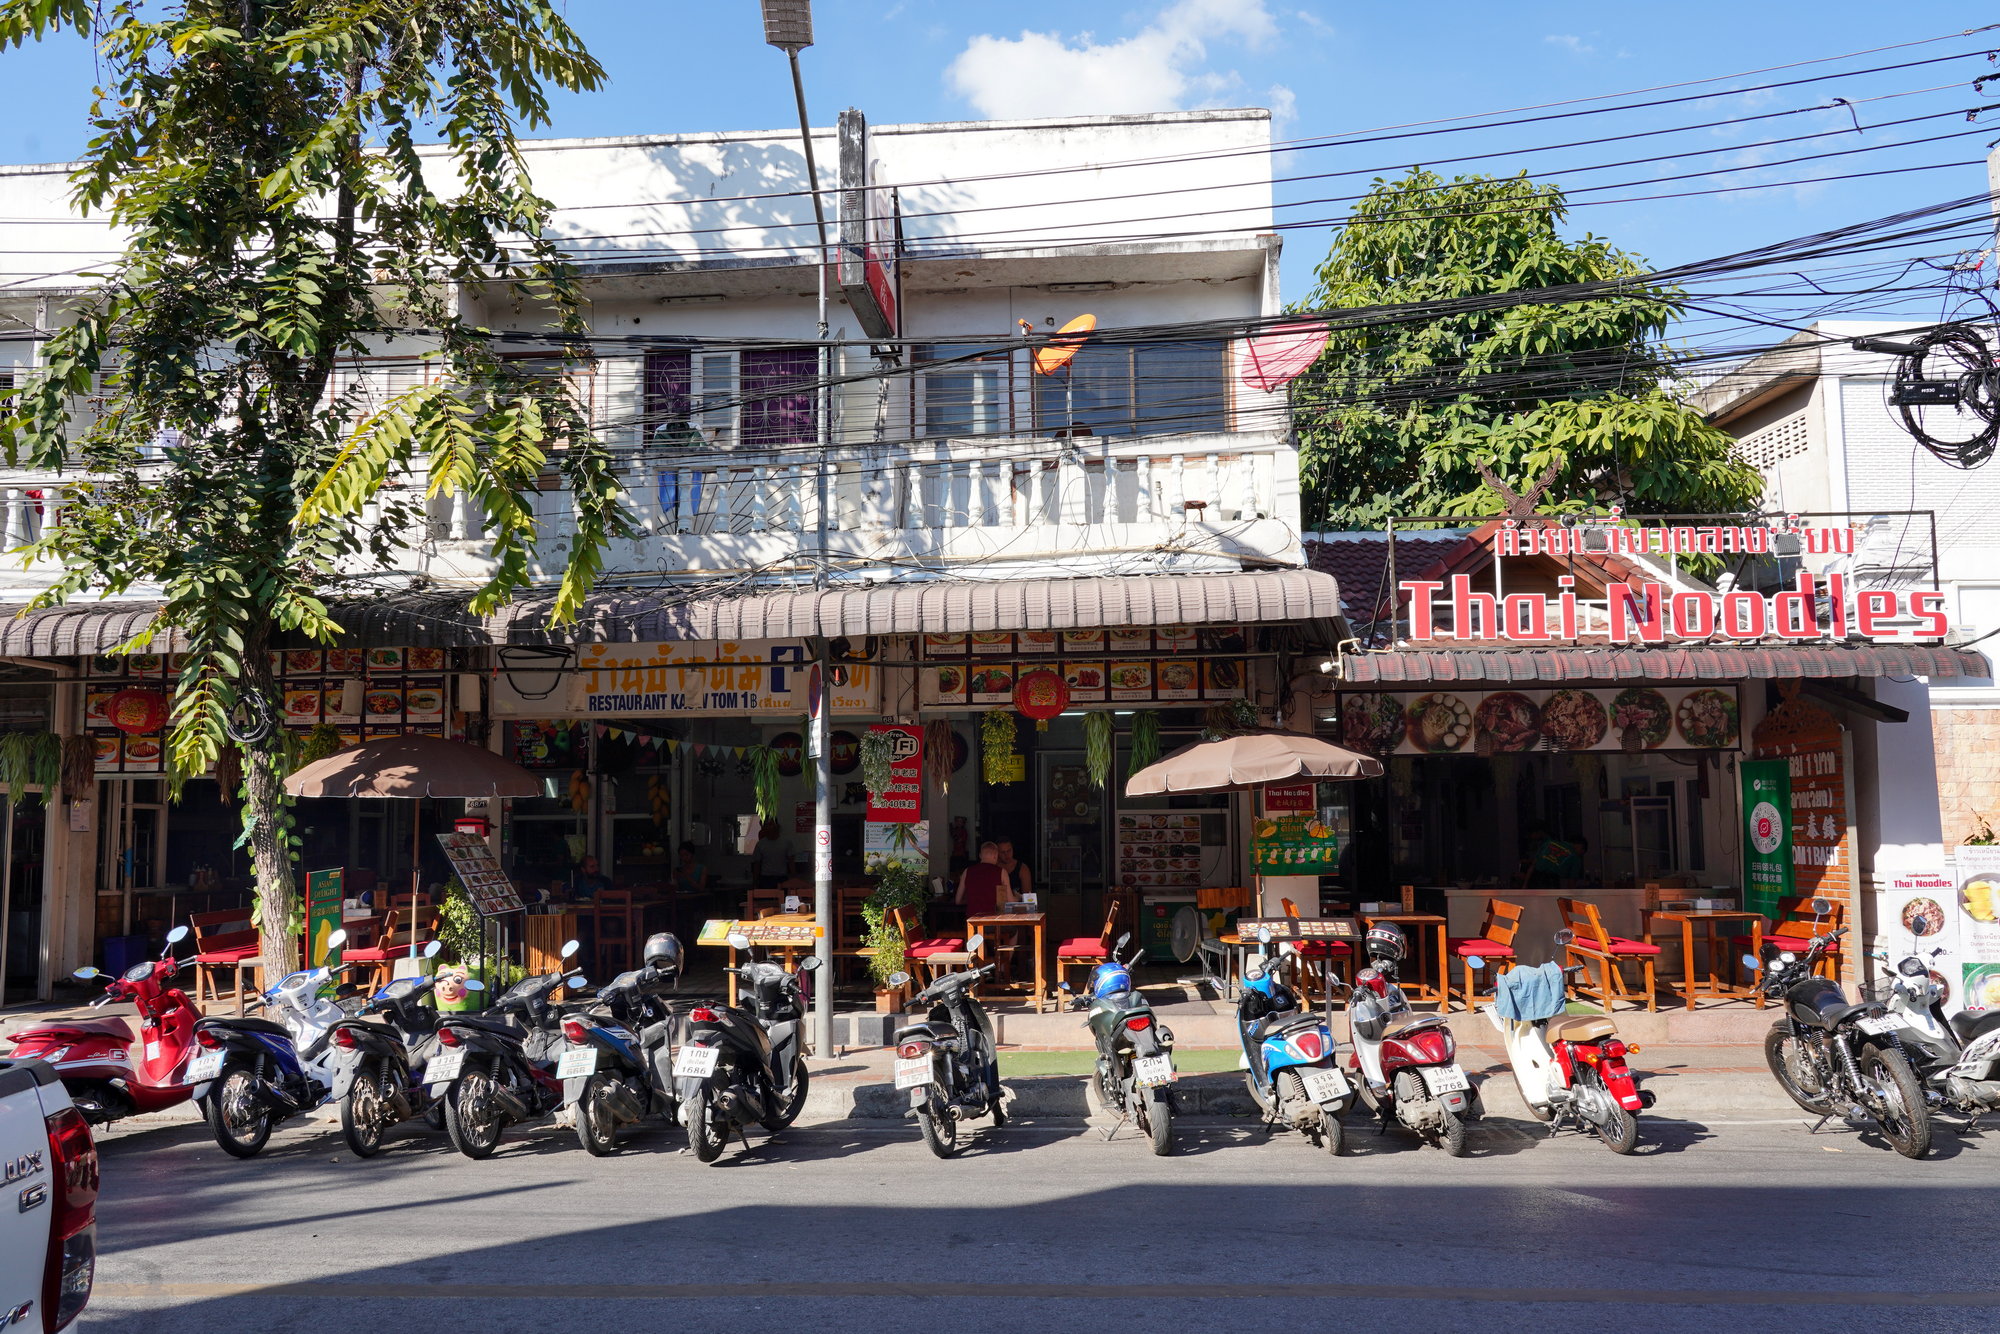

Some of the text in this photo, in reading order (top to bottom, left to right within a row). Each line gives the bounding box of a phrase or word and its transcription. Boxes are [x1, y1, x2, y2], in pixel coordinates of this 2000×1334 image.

[1400, 572, 1949, 643] Thai Noodles
[589, 694, 668, 712] RESTAURANT
[711, 692, 738, 709] TOM
[1284, 789, 1310, 797] Noodles
[1814, 845, 1840, 867] BAHT
[1894, 879, 1953, 888] Thai Noodles
[432, 1070, 451, 1080] 574
[682, 1066, 707, 1075] 1686
[1436, 1081, 1464, 1092] 7768
[1320, 1087, 1341, 1099] 314
[0, 1149, 44, 1186] LUX
[19, 1182, 47, 1214] G
